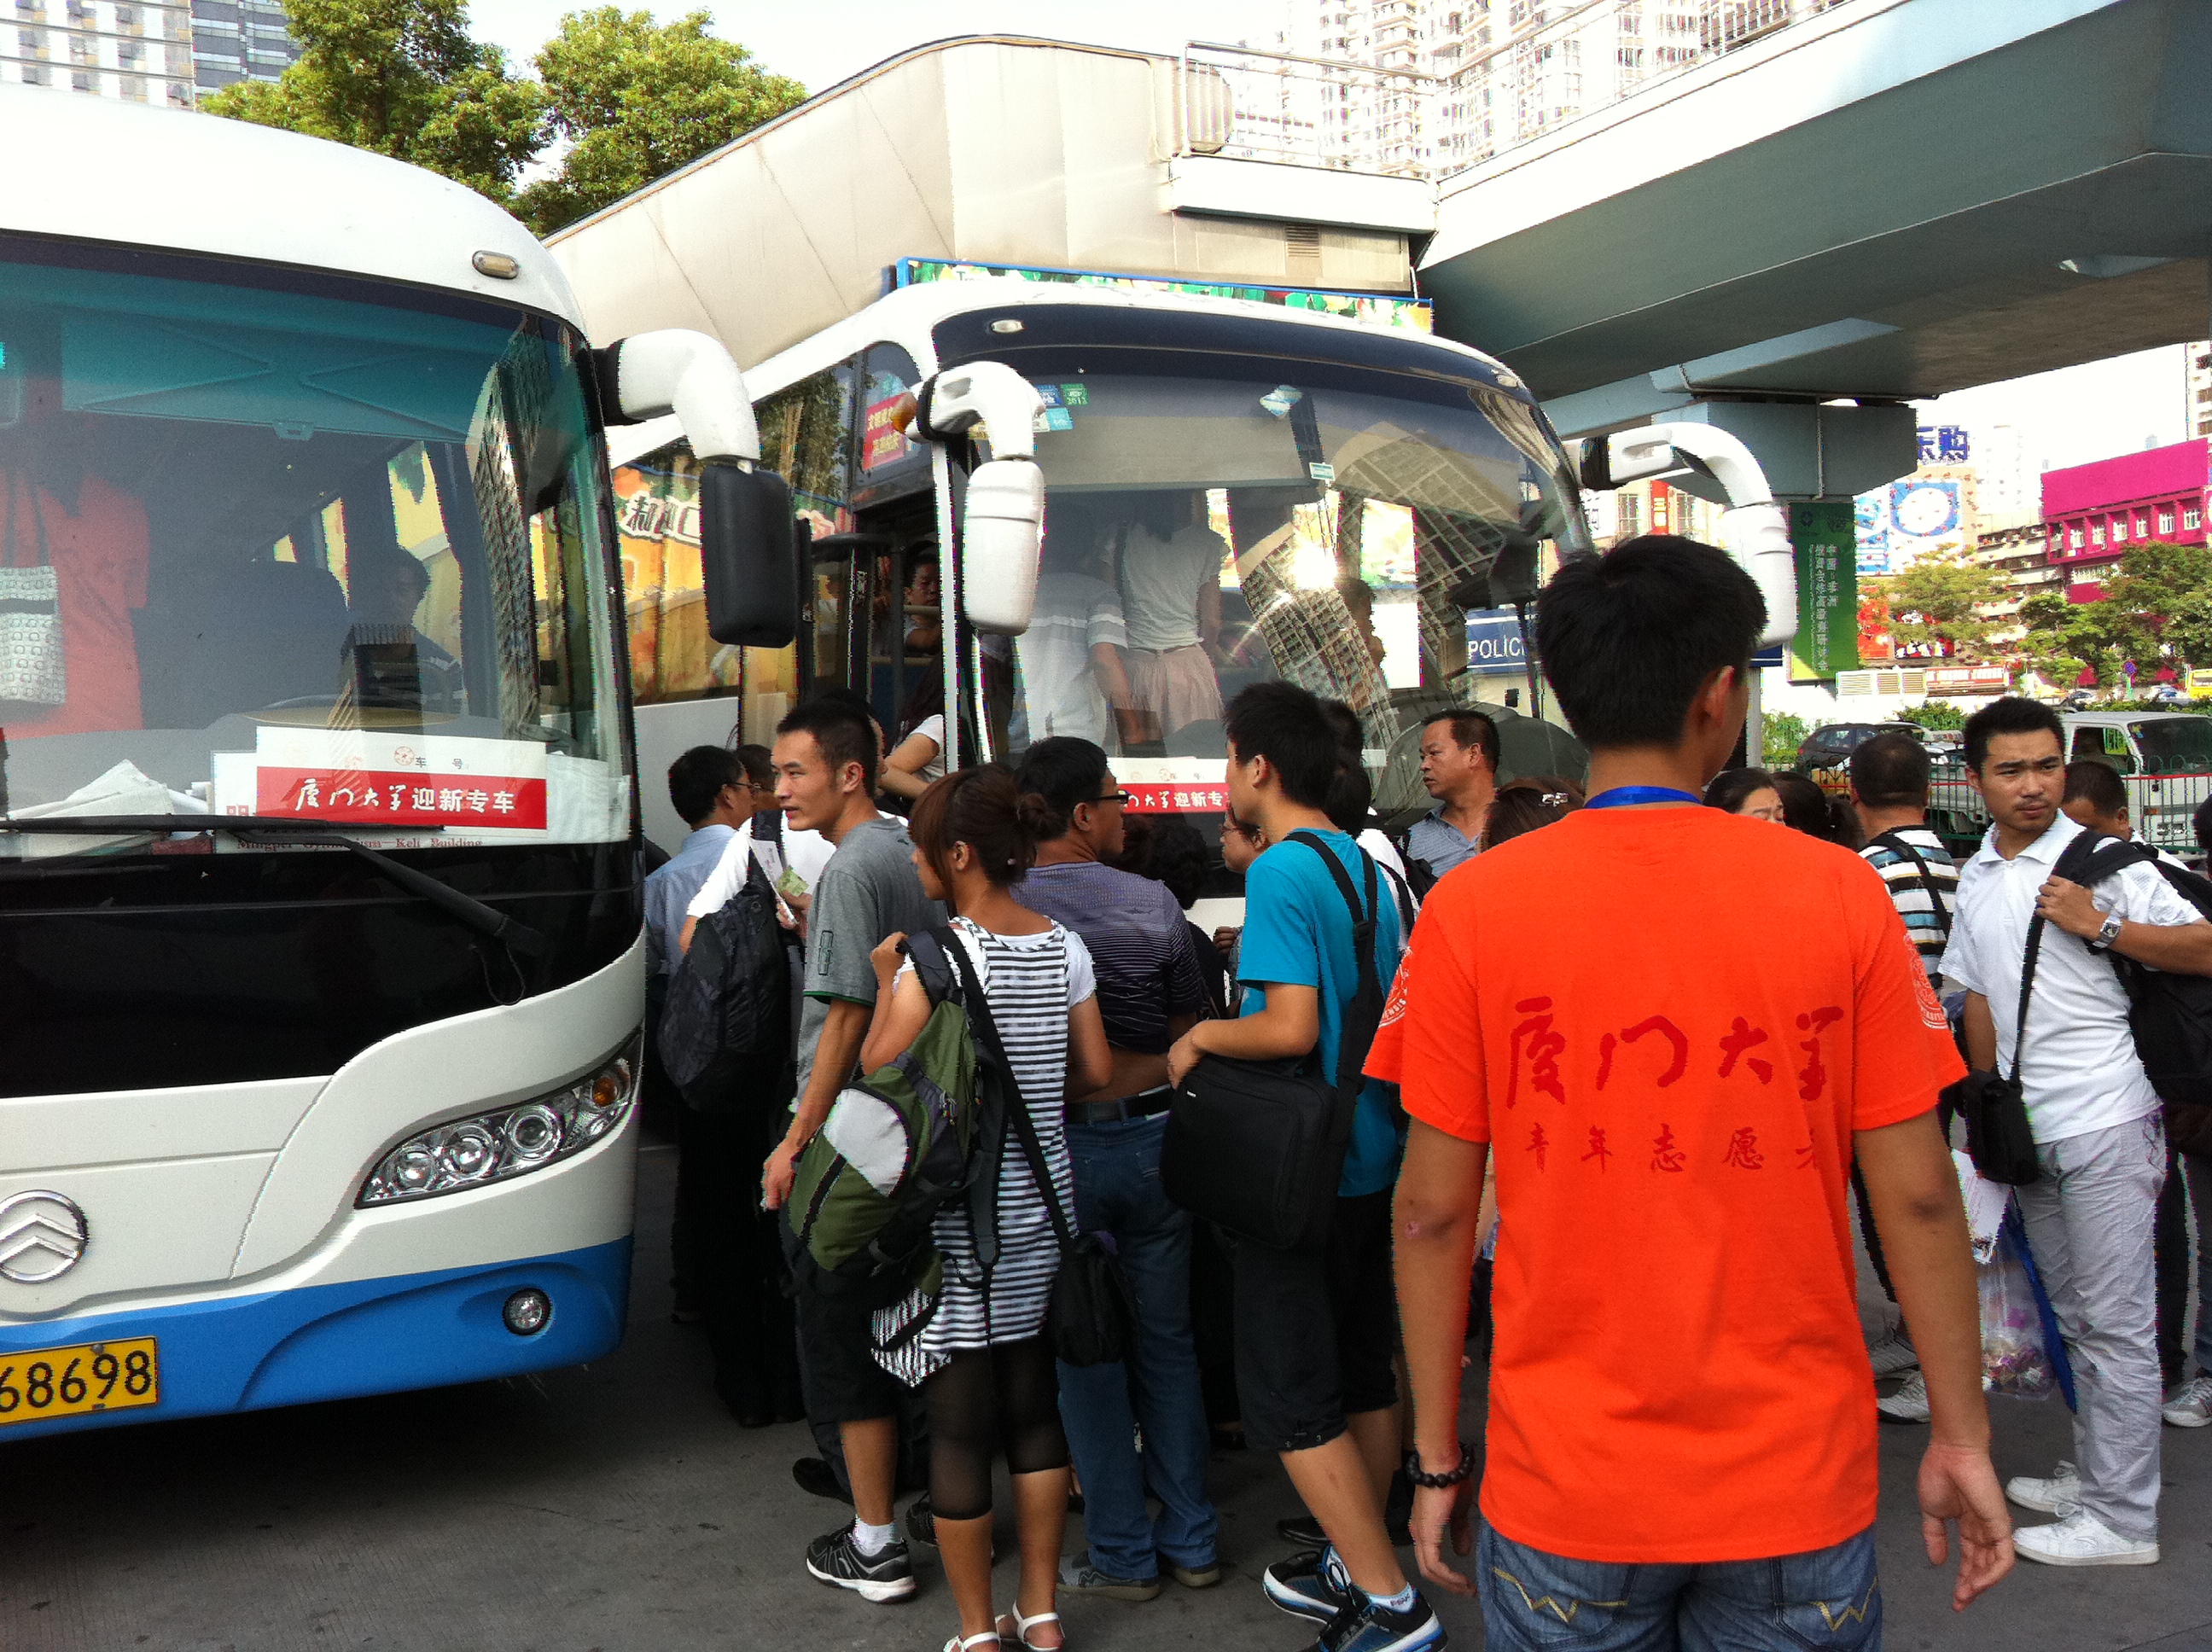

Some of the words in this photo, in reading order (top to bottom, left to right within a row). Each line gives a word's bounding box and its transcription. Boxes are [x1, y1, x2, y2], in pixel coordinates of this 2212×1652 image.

[1467, 634, 1526, 660] POLIC
[1506, 996, 1845, 1109] 厦门大学
[0, 1350, 152, 1413] 68698
